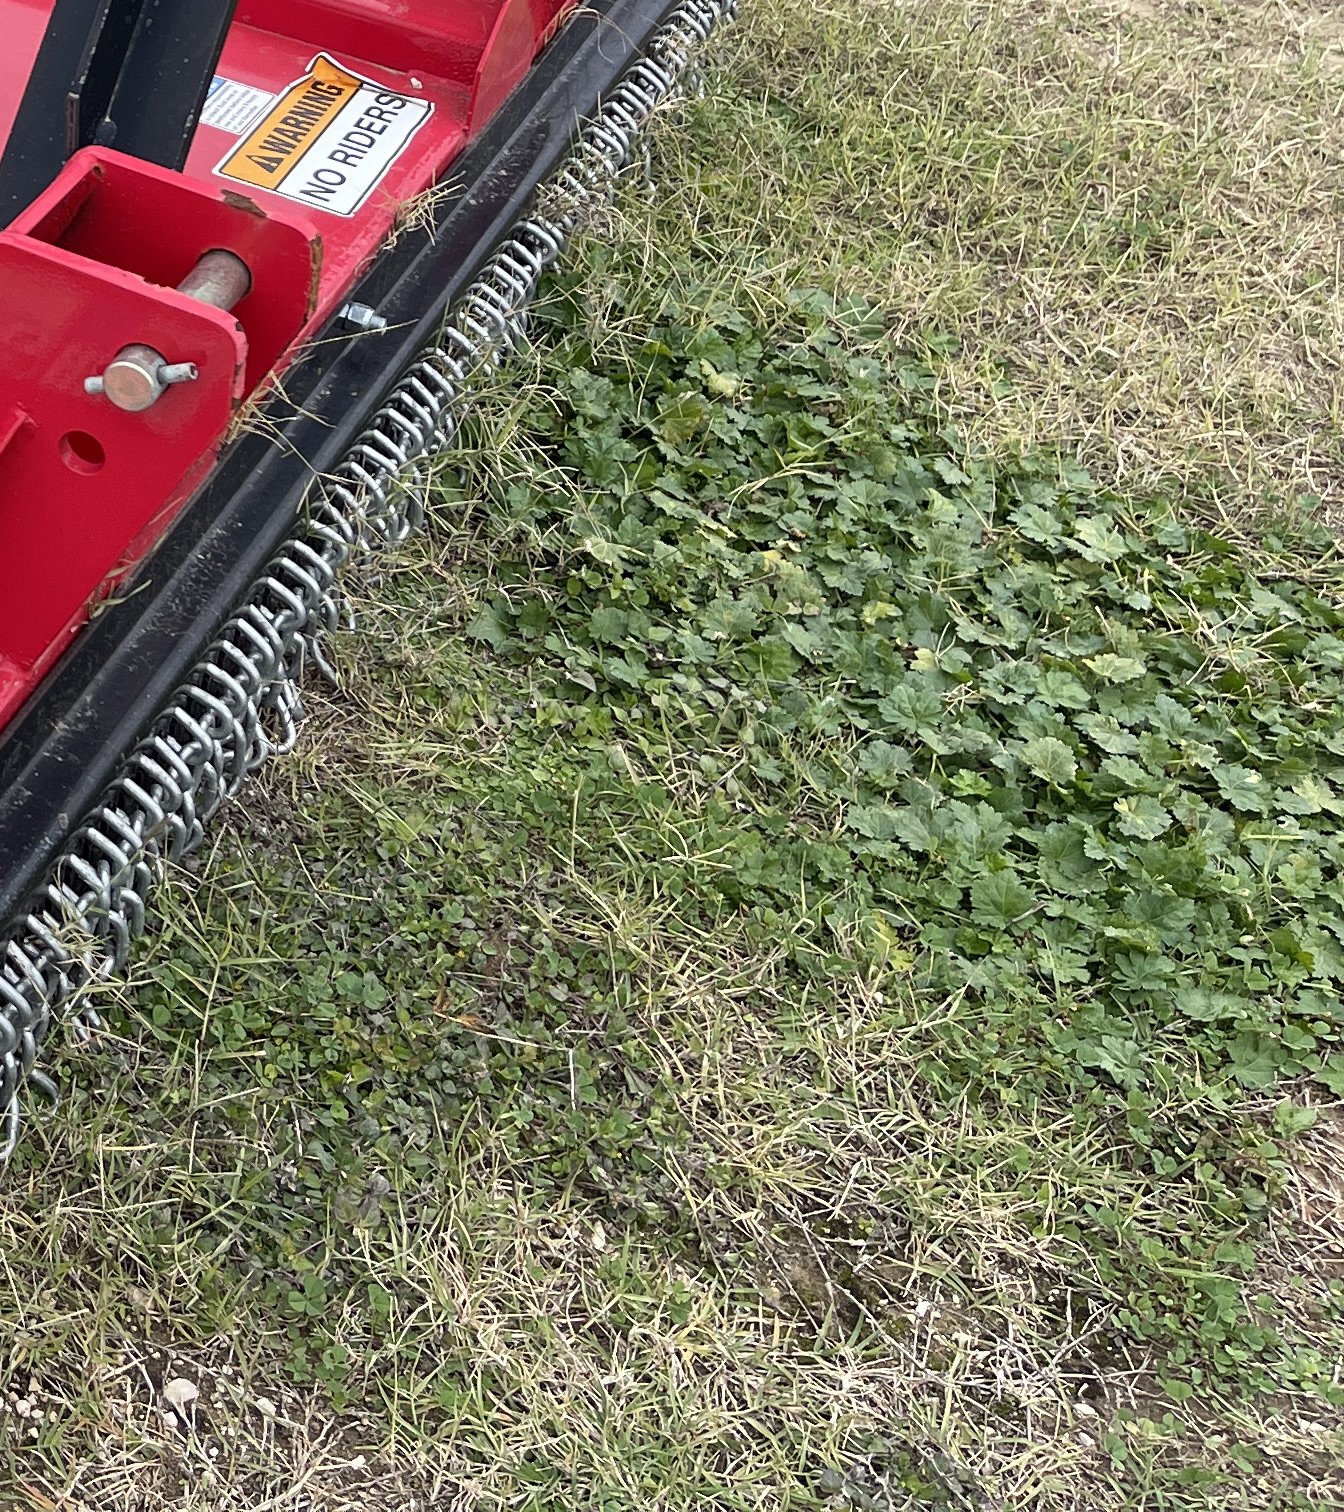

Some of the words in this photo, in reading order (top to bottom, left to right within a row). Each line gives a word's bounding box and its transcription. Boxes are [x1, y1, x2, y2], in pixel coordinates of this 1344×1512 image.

[259, 81, 345, 156] WARNING
[298, 168, 347, 202] NO
[328, 92, 407, 167] RIDERS
